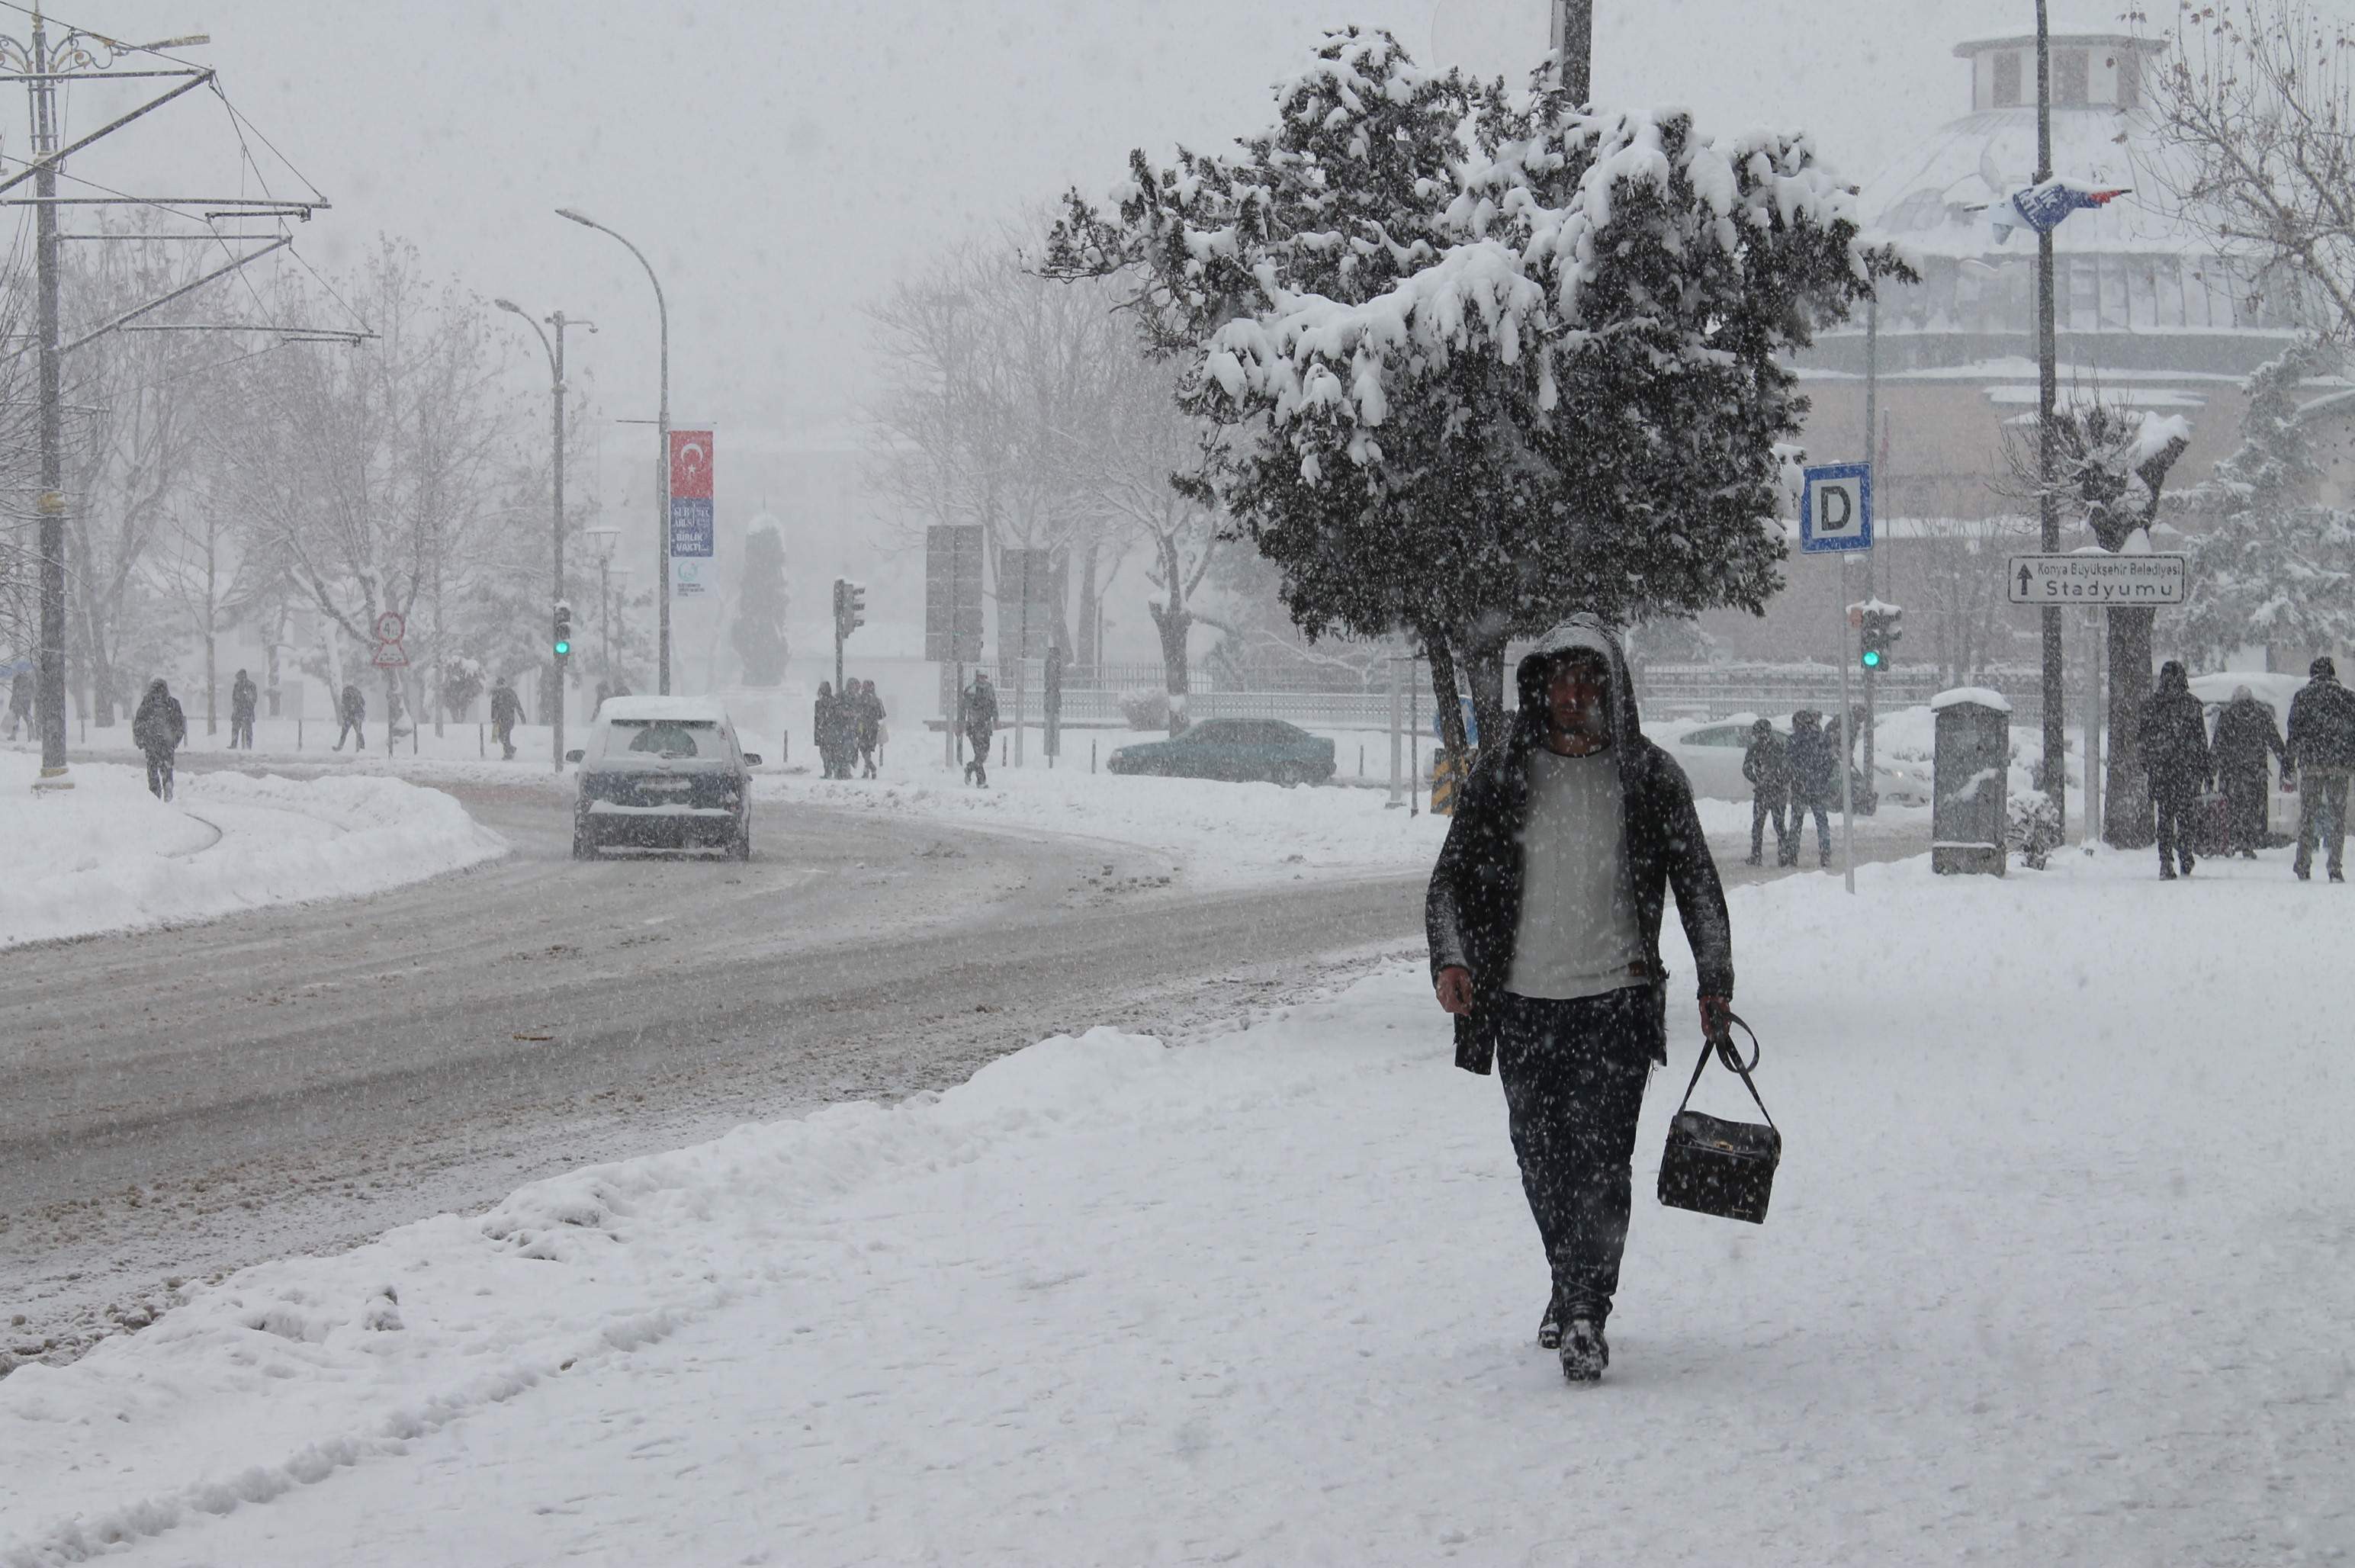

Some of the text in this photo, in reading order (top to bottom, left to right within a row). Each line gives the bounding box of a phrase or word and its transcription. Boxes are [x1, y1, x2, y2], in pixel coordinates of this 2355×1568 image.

[1820, 485, 1851, 532] D
[2038, 562, 2181, 579] Konya Büyükşehir Belediyesi
[2046, 580, 2173, 600] Stadyumu
